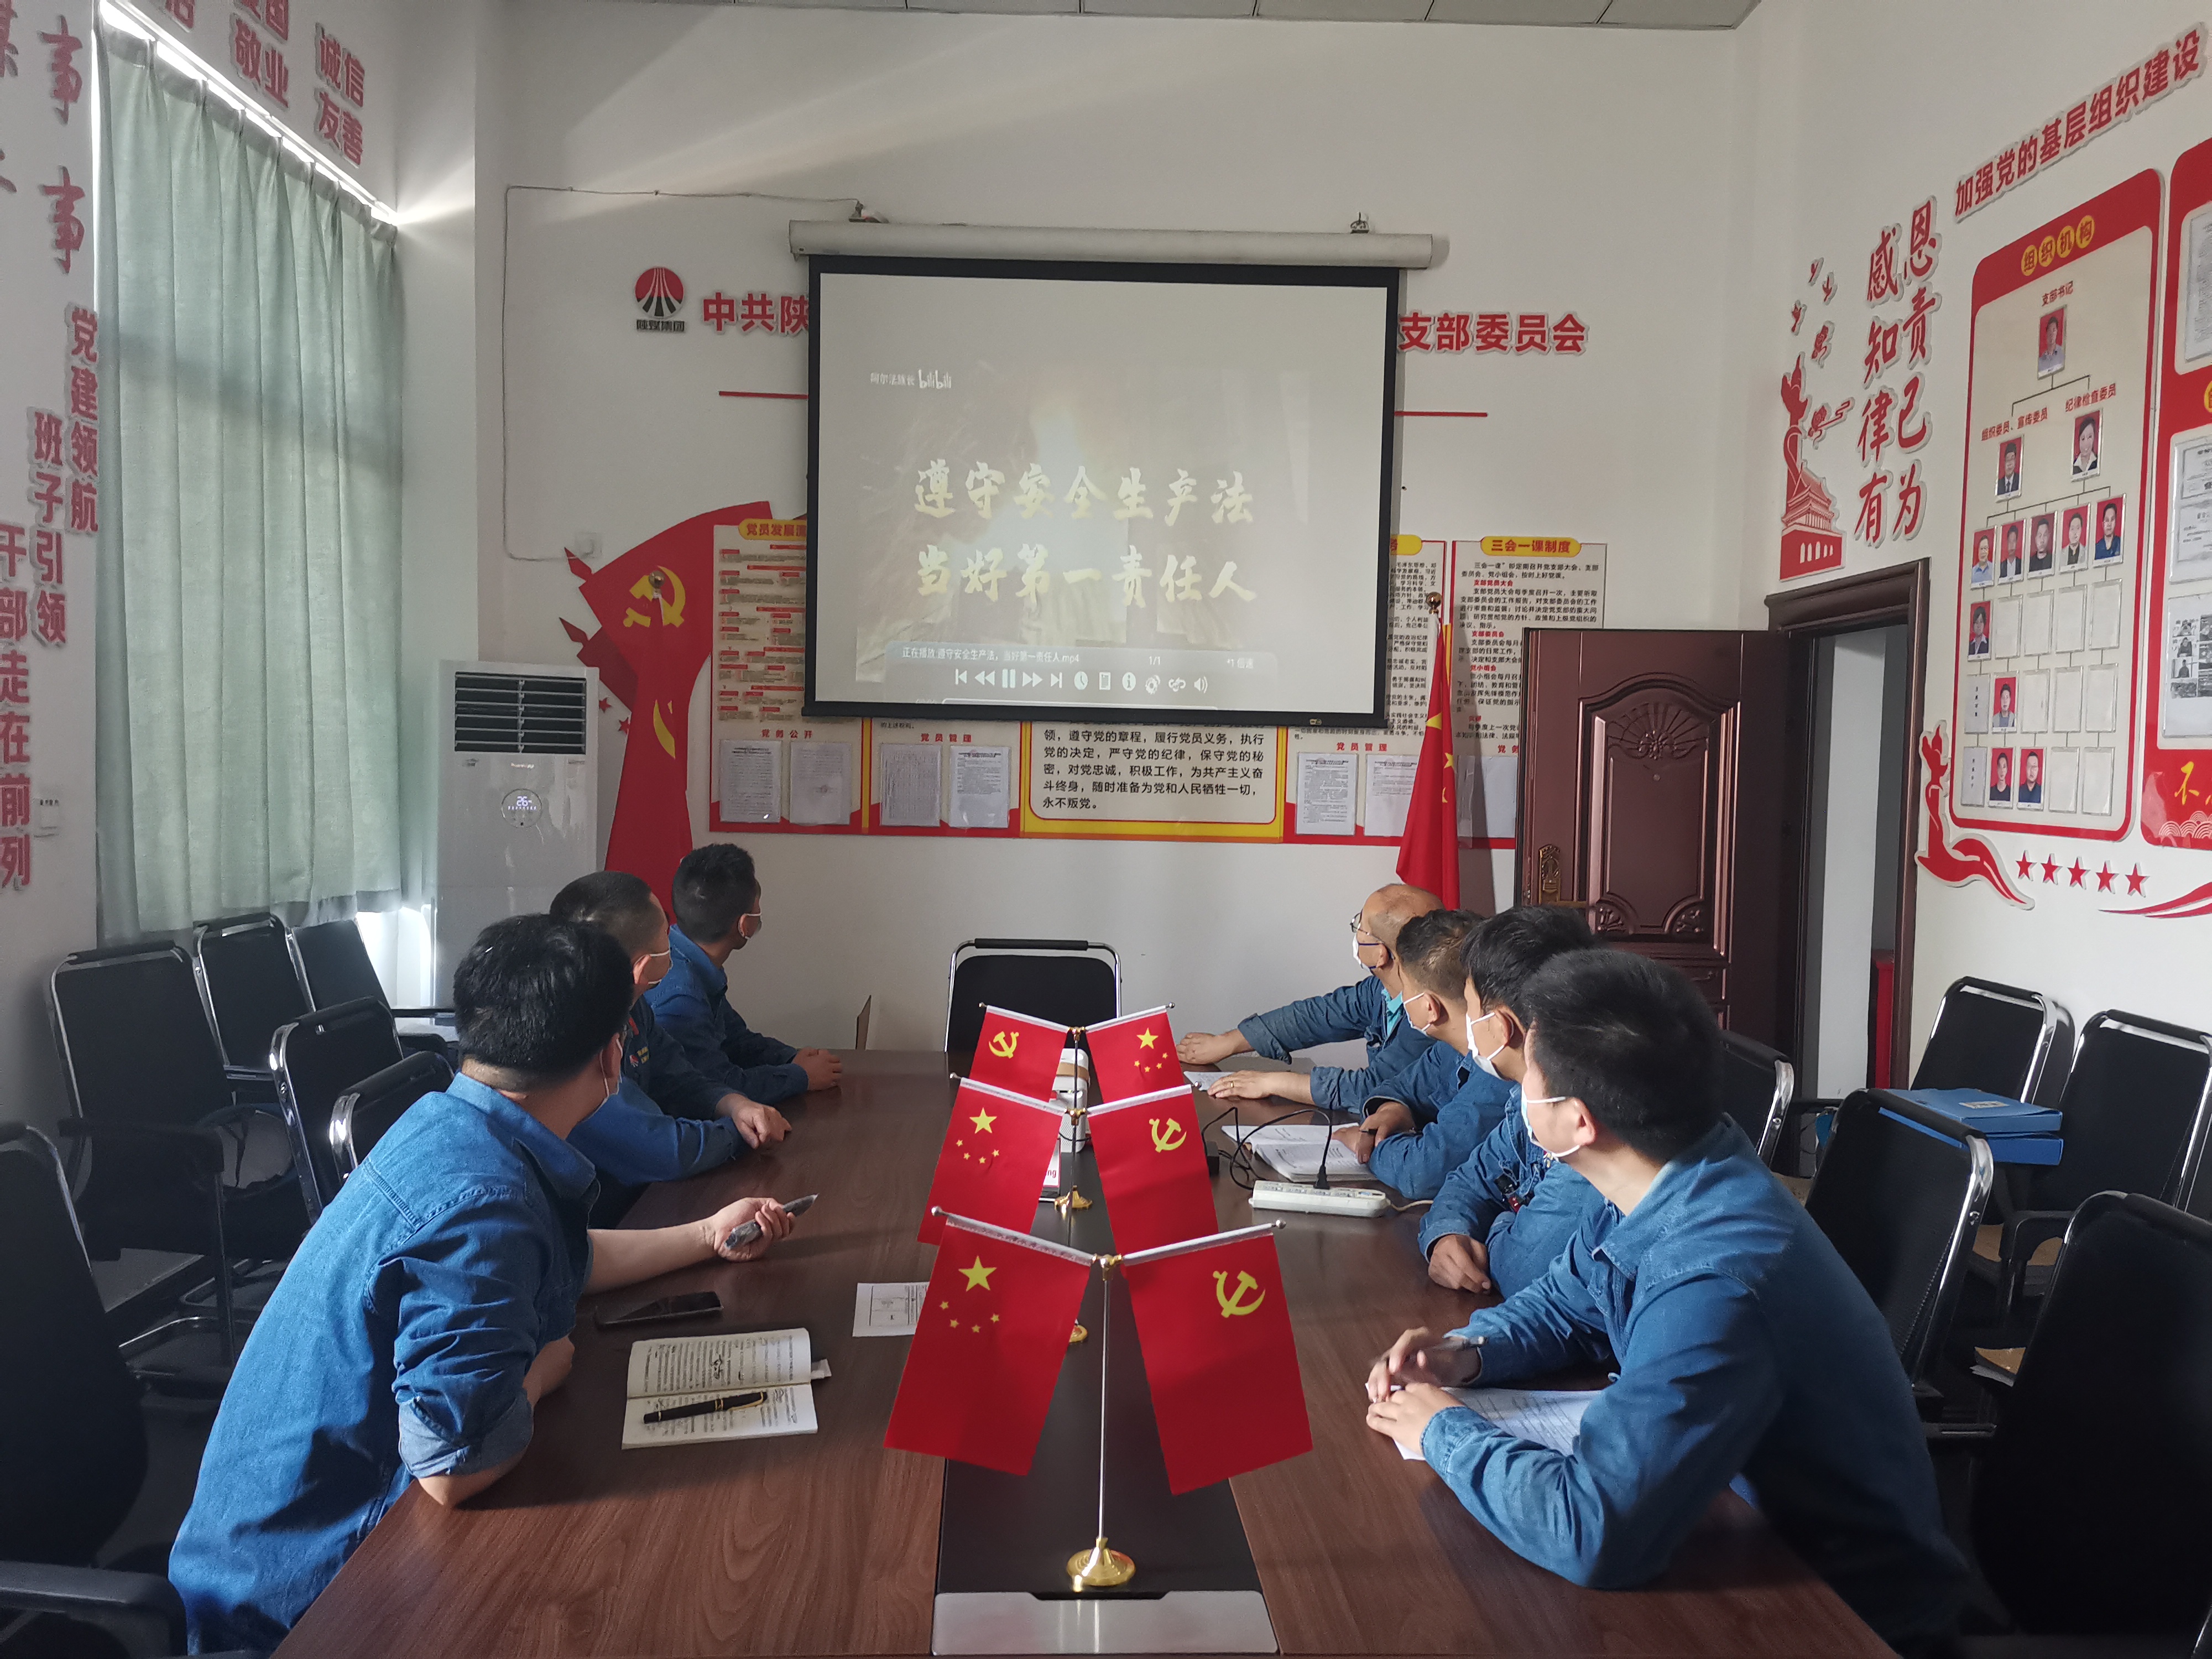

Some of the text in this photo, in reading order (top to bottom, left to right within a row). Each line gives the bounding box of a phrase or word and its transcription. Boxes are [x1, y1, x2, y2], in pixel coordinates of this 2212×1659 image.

[234, 18, 289, 108] 敬业
[319, 25, 364, 107] 诚信
[319, 91, 363, 165] 友善
[1955, 29, 2200, 216] 加强党的基层组织建设
[2025, 221, 2093, 272] 组织机构
[703, 292, 808, 333] 中共陕
[2042, 280, 2073, 306] 支部书记
[1399, 312, 1585, 352] 支部委员会
[918, 369, 952, 389] bilibili
[71, 307, 98, 532] 党建领航
[915, 458, 1254, 526] 遵守安全生产法
[33, 411, 66, 642] 班子引领
[1491, 539, 1571, 554] 三会一课制度
[918, 545, 1256, 609] 当好第一责任人
[0, 524, 30, 885] 干部走在前列
[1044, 746, 1264, 761] 党的决定，严守党的纪律，保守党的秘
[1337, 742, 1387, 751] 党员管理
[1044, 763, 1263, 779] 密，对党忠诚，积极工作，为共产主义奋
[1044, 780, 1257, 796] 斗终身，随时准备为党和人民牺牲一切，
[1044, 797, 1098, 809] 永不叛党。
